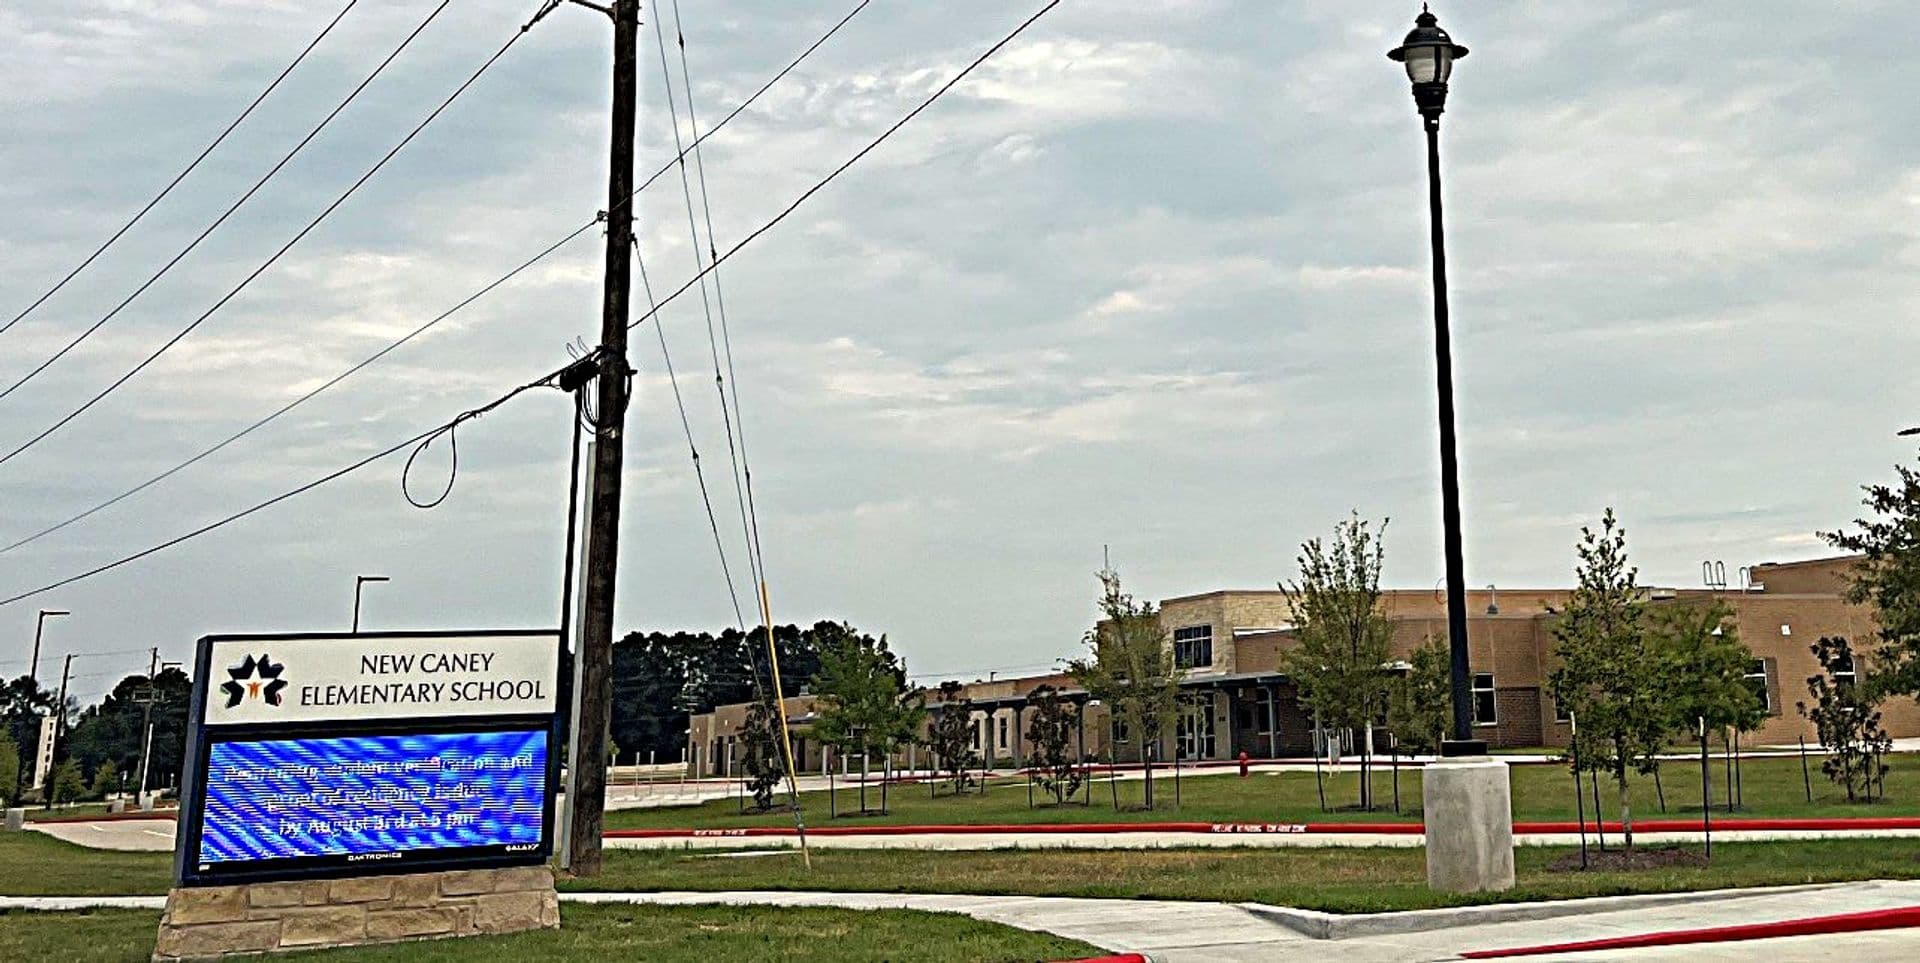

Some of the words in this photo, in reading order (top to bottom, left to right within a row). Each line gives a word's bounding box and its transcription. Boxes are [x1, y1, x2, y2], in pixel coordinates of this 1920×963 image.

[361, 654, 415, 674] NEW
[420, 652, 495, 674] CANEY
[301, 682, 445, 706] ELEMENTARY
[450, 680, 546, 702] SCHOOL
[501, 753, 533, 769] and
[280, 818, 301, 838] by
[308, 816, 368, 838] August
[446, 812, 475, 831] pm
